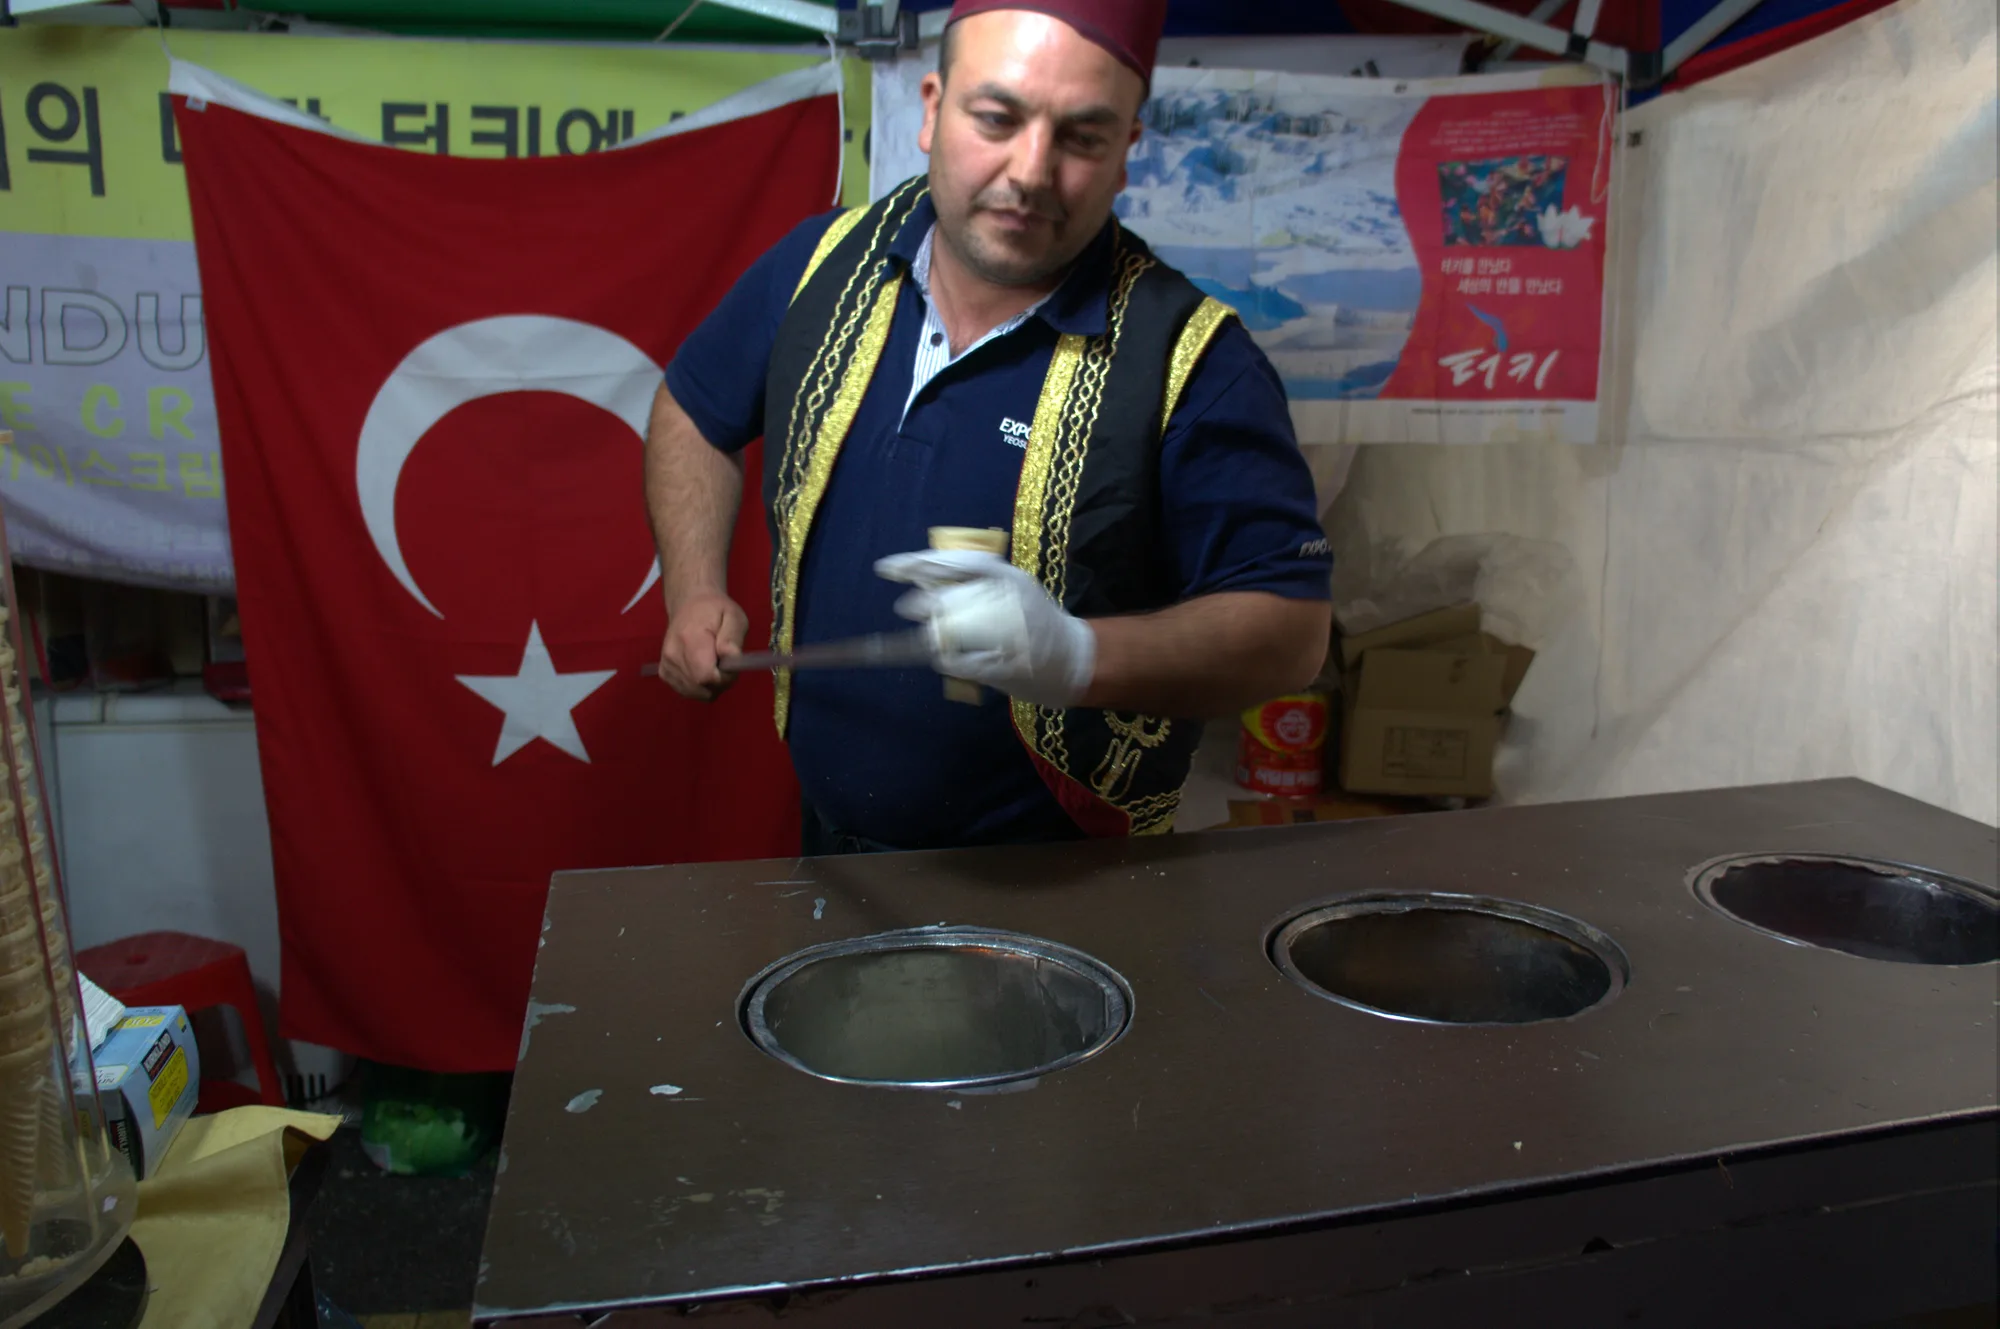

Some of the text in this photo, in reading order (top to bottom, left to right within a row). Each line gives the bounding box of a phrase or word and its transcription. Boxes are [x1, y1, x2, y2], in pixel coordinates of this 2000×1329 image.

[0, 81, 106, 198] 의
[381, 101, 686, 159] 터키에
[1438, 347, 1560, 390] 터키
[116, 1121, 132, 1164] KIRKLA
